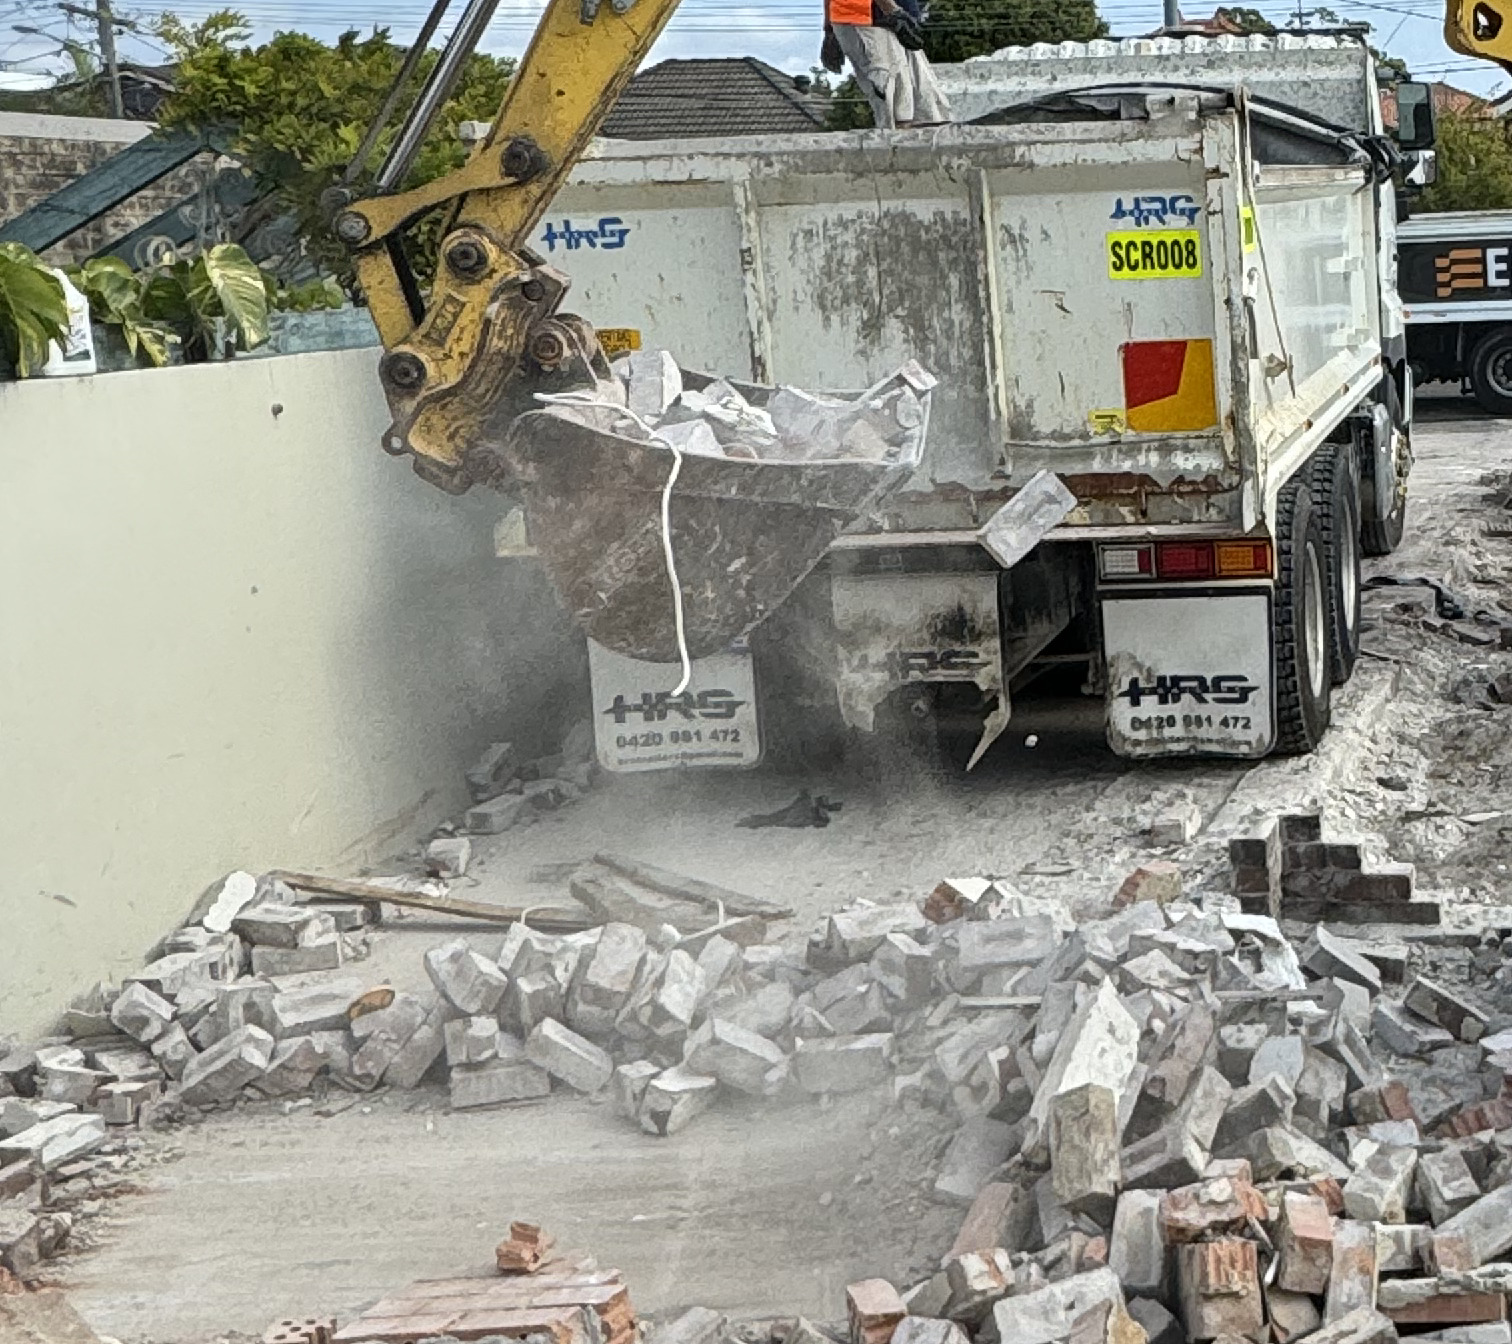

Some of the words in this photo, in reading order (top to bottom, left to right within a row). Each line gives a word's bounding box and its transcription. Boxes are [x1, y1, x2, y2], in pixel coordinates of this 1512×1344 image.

[1110, 238, 1198, 272] SCR008
[603, 688, 746, 724] HRS
[1117, 674, 1260, 707] HRS
[616, 730, 664, 749] 0420
[708, 727, 741, 744] 472
[1219, 714, 1252, 730] 472
